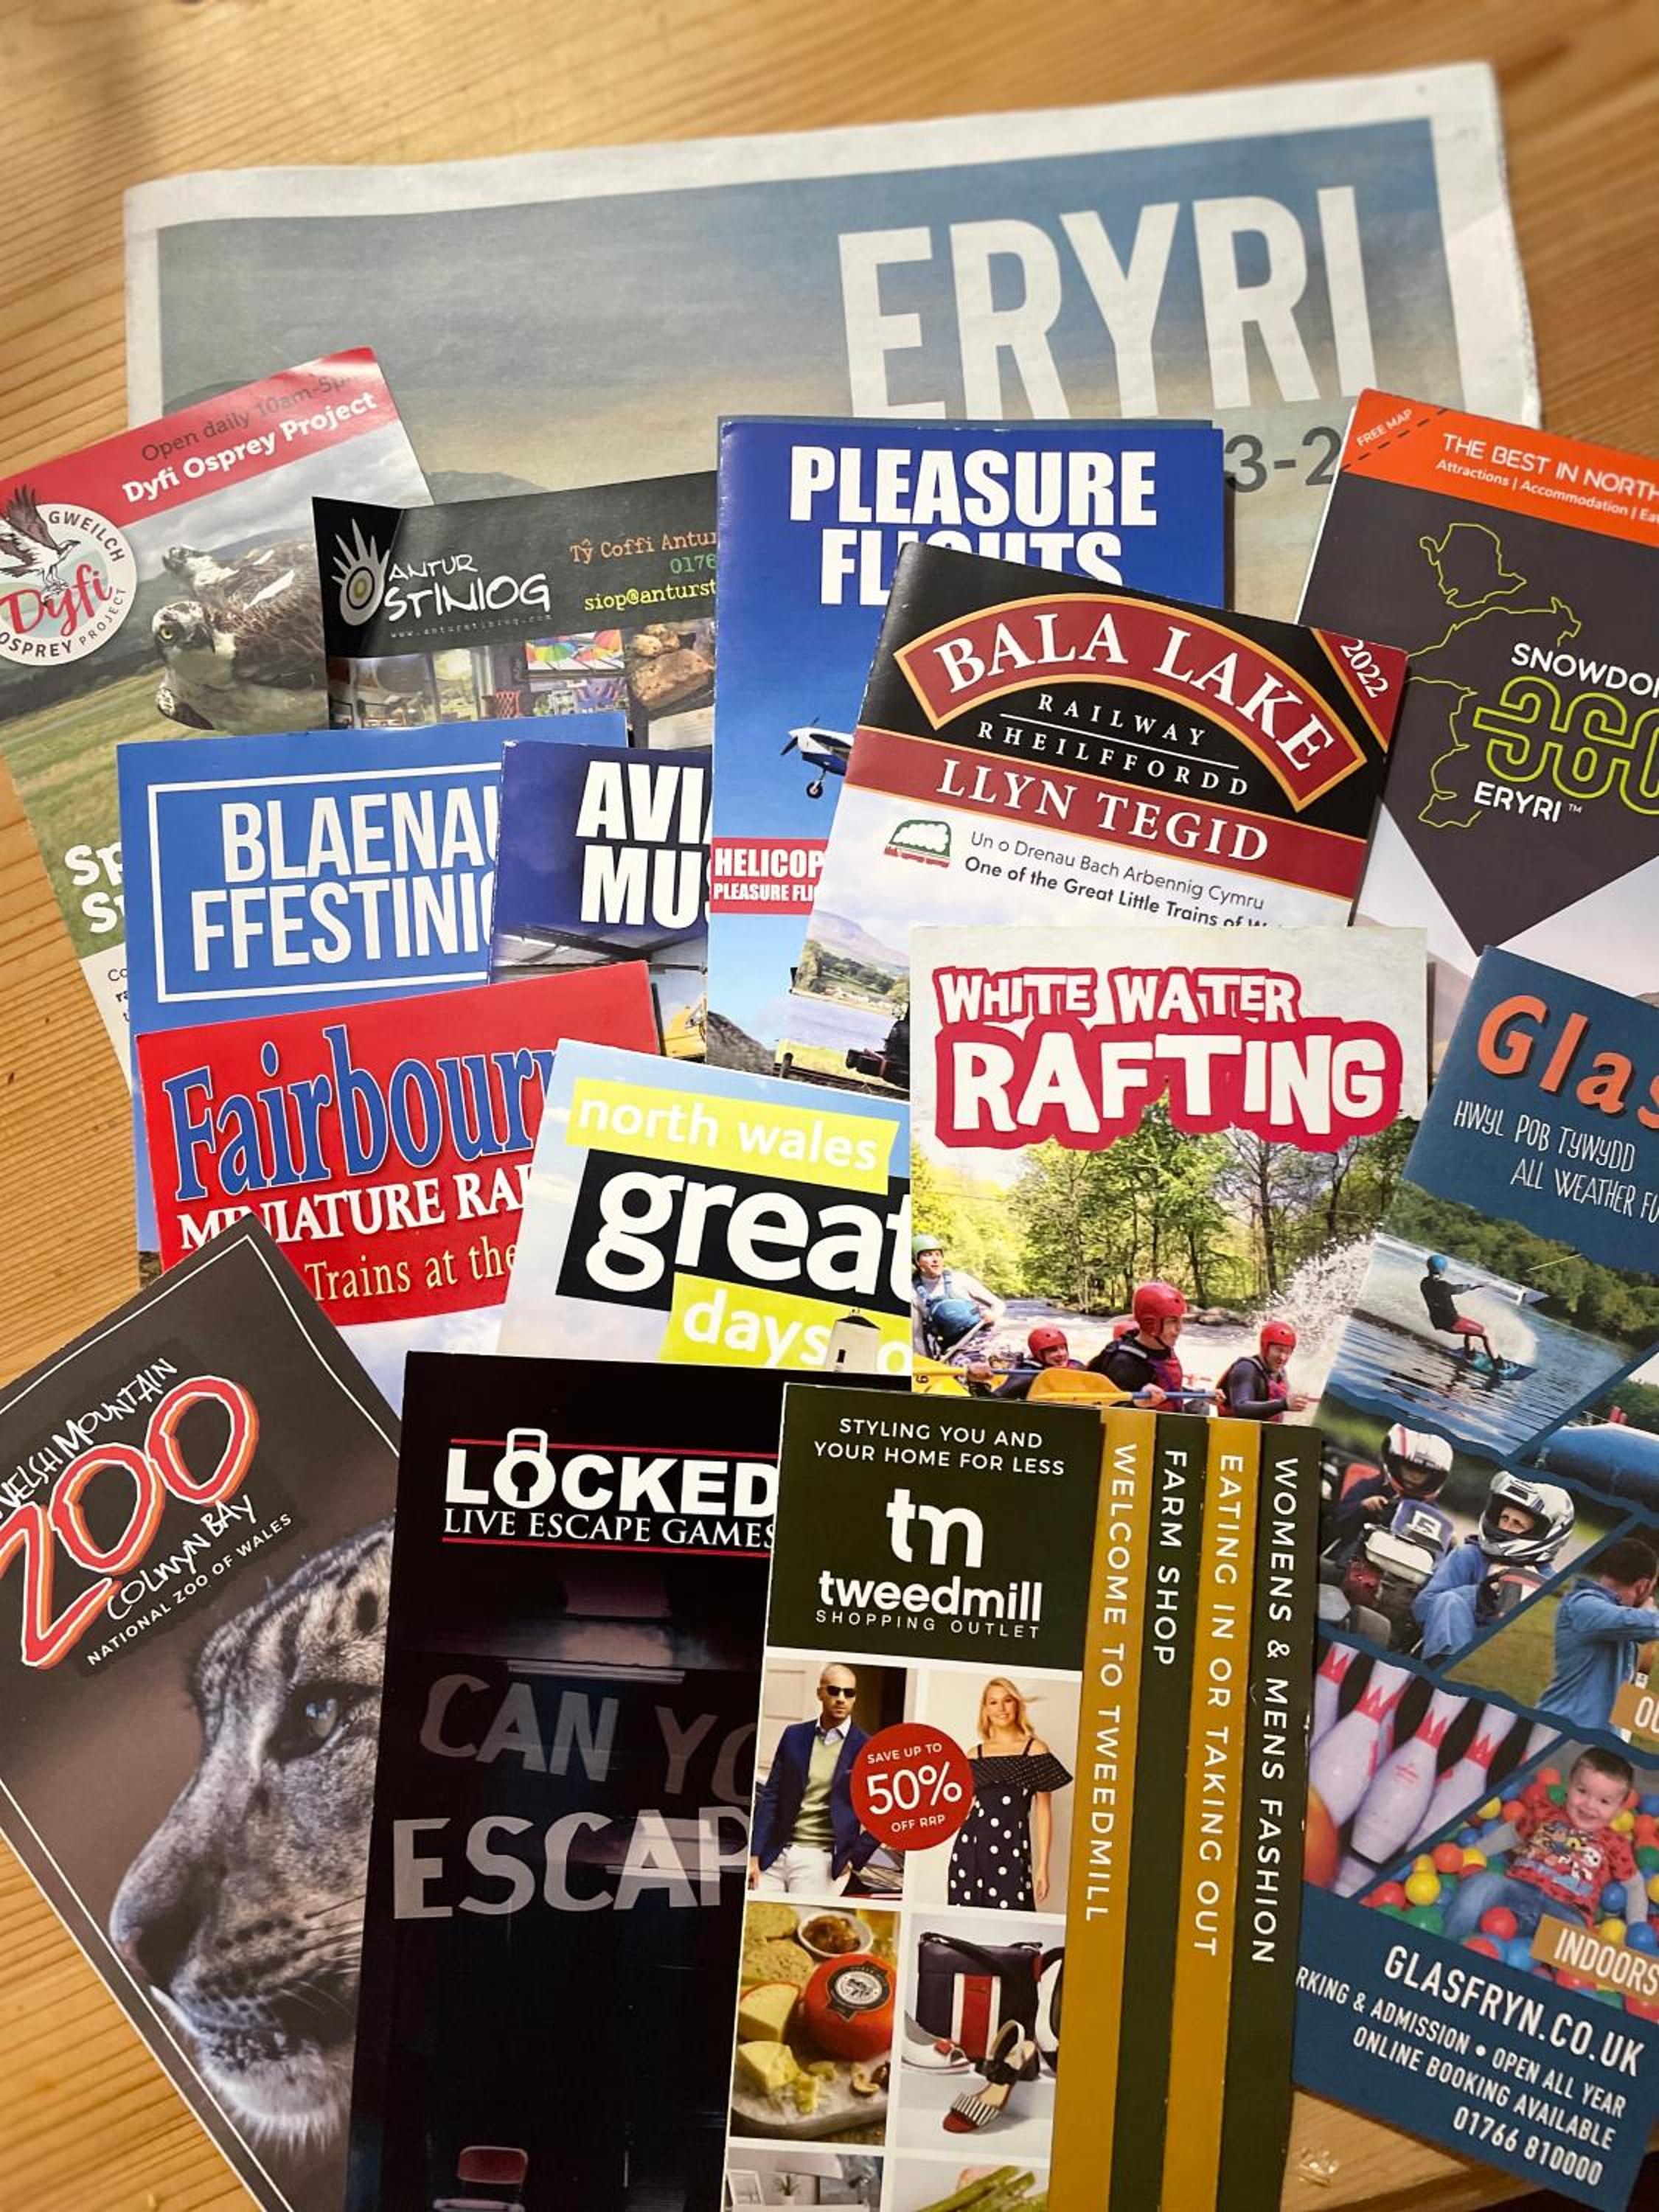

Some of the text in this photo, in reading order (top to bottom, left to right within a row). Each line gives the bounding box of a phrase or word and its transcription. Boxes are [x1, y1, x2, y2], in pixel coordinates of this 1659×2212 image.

[838, 186, 1376, 420] ERYRI
[122, 391, 378, 503] Dyfi Osprey Project
[142, 433, 199, 462] Open
[204, 413, 251, 441] daily
[1356, 408, 1414, 448] FREE MAP
[1443, 432, 1486, 459] THE
[1491, 445, 1551, 476] BEST
[1556, 461, 1579, 483] IN
[789, 445, 1158, 527] PLEASURE
[1436, 459, 1510, 487] Attractions
[1520, 480, 1629, 516] Accommodation
[49, 511, 125, 562] GWEILCH
[388, 554, 479, 582] ANTUR
[601, 536, 655, 558] Coffi
[669, 553, 717, 575] 0176
[0, 564, 113, 636] Dyfi
[79, 588, 126, 645] PROJECT
[384, 574, 551, 622] STINIOG
[584, 579, 717, 611] siop@anturst
[933, 612, 1336, 773] BALA LAKE
[1340, 639, 1389, 698] 2022
[1037, 692, 1206, 748] RAILWAY
[977, 720, 1249, 798] RHEILFFORDD
[936, 758, 1269, 863] LLYN TEGID
[1473, 781, 1562, 823] ERYRI
[714, 848, 826, 879] HELICOP
[714, 883, 789, 901] PLEASURE
[964, 856, 1002, 877] One
[1008, 863, 1027, 882] of
[1031, 869, 1057, 890] the
[1064, 877, 1113, 902] Great
[1119, 890, 1161, 914] Little
[1166, 901, 1218, 927] Trains
[971, 831, 1265, 910] Un o Drenau Bach Arbennig Cymru
[191, 869, 495, 973] FFESTINI
[939, 973, 1296, 1023] WHITE WATER
[952, 1032, 1386, 1135] RAFTING
[578, 1096, 877, 1171] north wales
[1453, 1099, 1635, 1172] HWYL POB TYWYDD
[1509, 1158, 1545, 1190] ALL
[1554, 1168, 1636, 1218] WEATHER
[305, 1235, 518, 1302] Trains at the
[585, 1171, 911, 1305] great
[683, 1287, 833, 1368] days
[52, 1357, 178, 1459] MOUNTAIN
[840, 1419, 1043, 1450] STYLING YOU AND
[445, 1427, 779, 1518] LOCKED
[814, 1441, 1065, 1475] YOUR HOME FOR LESS
[0, 1375, 260, 1670] ZOO
[107, 1495, 257, 1621] COLWYN BAY
[443, 1508, 777, 1549] LIVE ESCAPE GAMES
[886, 1488, 984, 1568] tm
[1152, 1450, 1187, 1665] FARM SHOP
[86, 1512, 293, 1666] NATIONAL ZOO OF WALES
[815, 1610, 1040, 1639] SHOPPING OUTLET
[818, 1570, 1043, 1622] tweedmill
[1085, 1443, 1137, 1921] WELCOME TO TWEEDMILL
[1194, 1454, 1244, 1956] EATING IN OR TAKING OUT
[1251, 1457, 1298, 1963] WOMENS & MENS FASHION
[419, 1674, 619, 1783] CAN
[867, 1742, 943, 1764] SAVE UP TO
[866, 1761, 962, 1815] 50%
[891, 1815, 946, 1832] OFF RRP
[393, 1806, 751, 1921] ESCAP
[1553, 1927, 1659, 1997] INDOORS
[1295, 1966, 1627, 2119] RKING & ADMISSION OPEN ALL YEAR
[1383, 1944, 1645, 2077] GLASFRYN.CO.UK
[1352, 2025, 1617, 2151] ONLINE BOOKING AVAILABLE
[1453, 2107, 1604, 2187] 01766 810000
